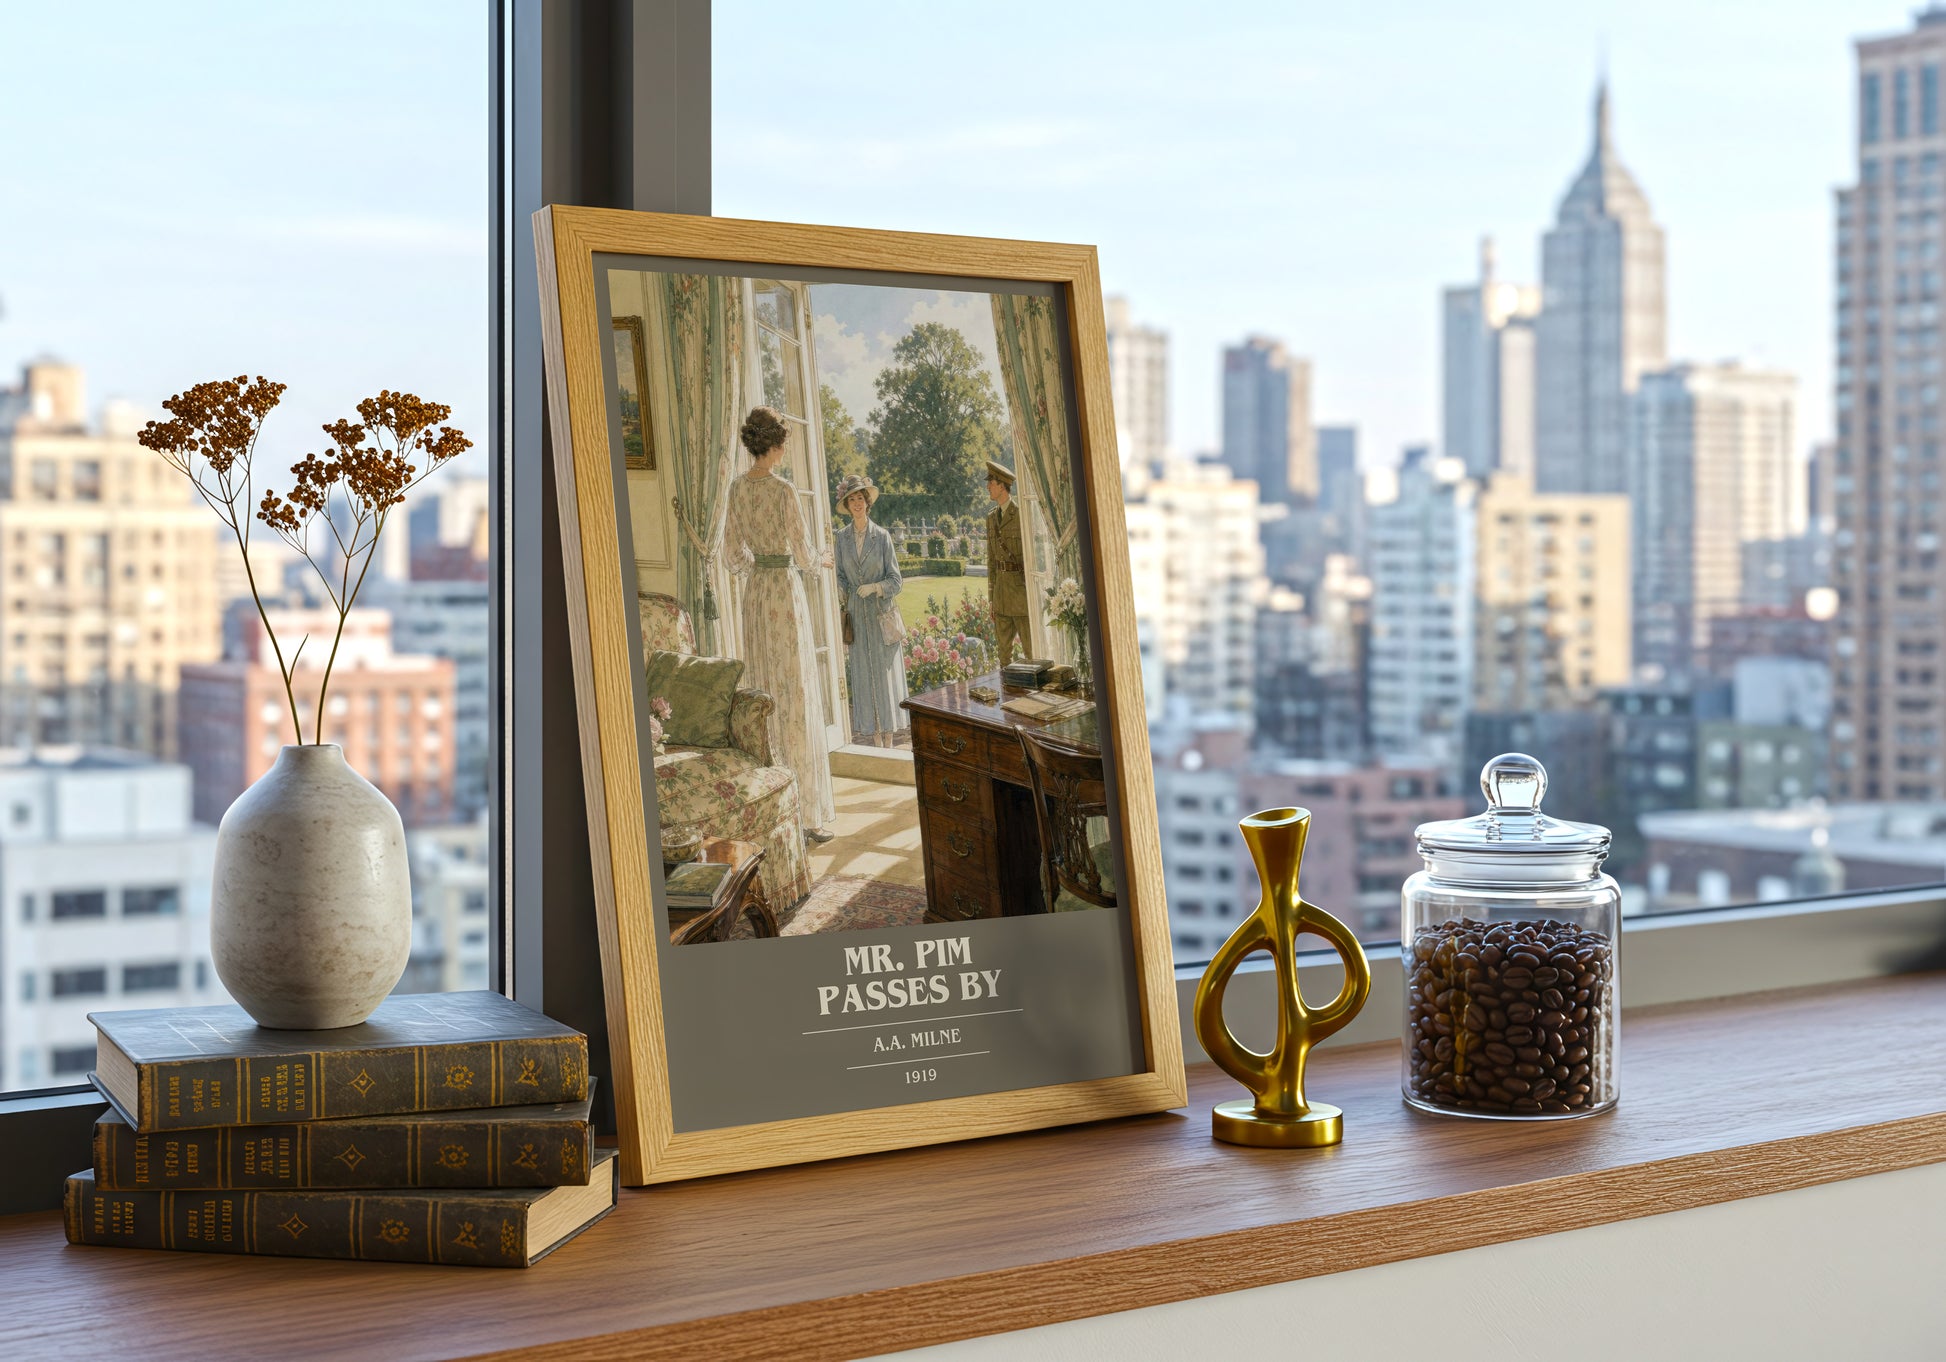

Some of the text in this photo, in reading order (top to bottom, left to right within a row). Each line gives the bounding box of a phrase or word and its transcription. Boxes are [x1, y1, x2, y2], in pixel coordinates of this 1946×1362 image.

[843, 936, 973, 976] MR. PIM
[817, 969, 1002, 1016] PASSES BY
[873, 1028, 962, 1052] A.A. MILNE
[904, 1068, 938, 1084] 1919
